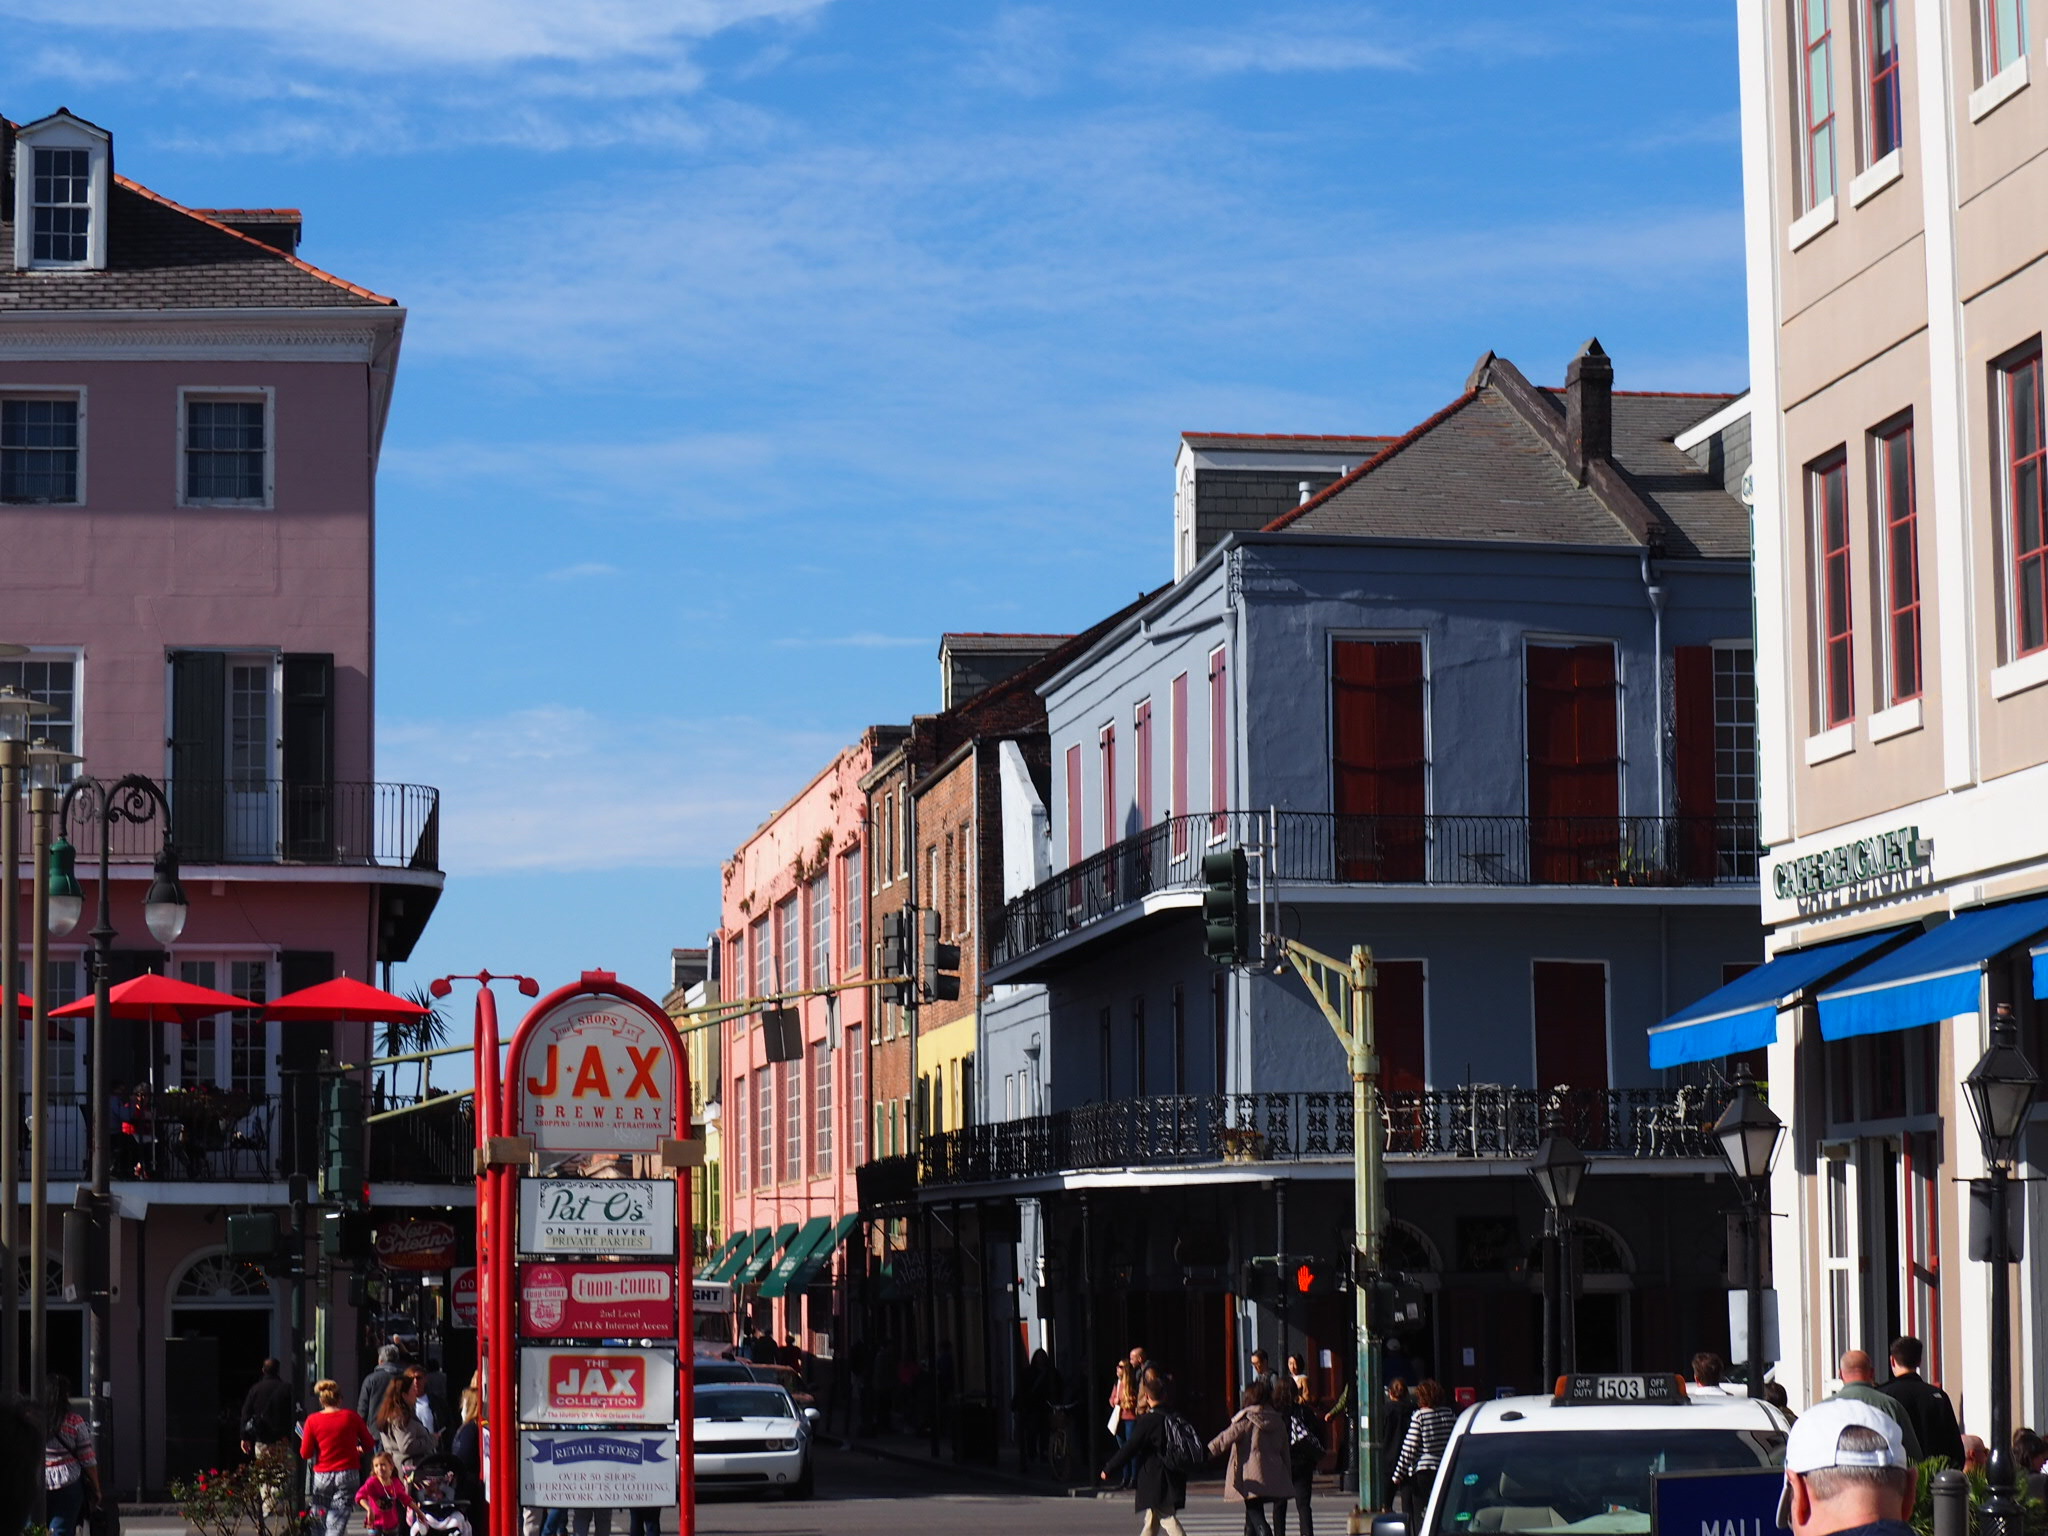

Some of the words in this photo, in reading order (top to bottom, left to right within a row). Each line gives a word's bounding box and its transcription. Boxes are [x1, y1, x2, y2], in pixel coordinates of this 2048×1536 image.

[1822, 826, 1914, 889] BEIGNET
[558, 1026, 571, 1035] THE
[578, 1015, 618, 1026] SHOPS
[626, 1028, 635, 1037] AT
[527, 1044, 664, 1101] JAX
[535, 1105, 662, 1121] BREWERY
[613, 1121, 662, 1129] ATTRACTIONS
[548, 1189, 590, 1221] Pat
[604, 1191, 644, 1222] O's
[546, 1227, 566, 1235] ON
[552, 1236, 596, 1246] PRIVATE
[601, 1237, 643, 1246] PARTIES
[460, 1281, 475, 1290] DO
[600, 1309, 616, 1318] 2nd
[618, 1309, 641, 1318] Level
[572, 1322, 593, 1330] ATM
[595, 1322, 603, 1330] &
[606, 1321, 639, 1330] Internet
[641, 1322, 669, 1330] Access
[585, 1359, 609, 1368] THE
[556, 1368, 637, 1396] JAX
[1575, 1378, 1591, 1387] OFF
[1650, 1378, 1665, 1387] OFF
[1573, 1388, 1593, 1397] DUTY
[1598, 1379, 1639, 1399] 1503
[1648, 1388, 1668, 1397] DUTY
[556, 1397, 637, 1406] COLLECTION
[555, 1444, 595, 1459] RETAIL
[598, 1444, 640, 1459] STORES
[558, 1472, 587, 1481] OVER
[604, 1472, 637, 1481] SHOPS
[525, 1482, 577, 1491] OFFERING
[580, 1482, 611, 1492] GIFTS,
[614, 1482, 670, 1492] CLOTHING,
[543, 1492, 594, 1501] ARTWORK
[597, 1492, 620, 1501] AND
